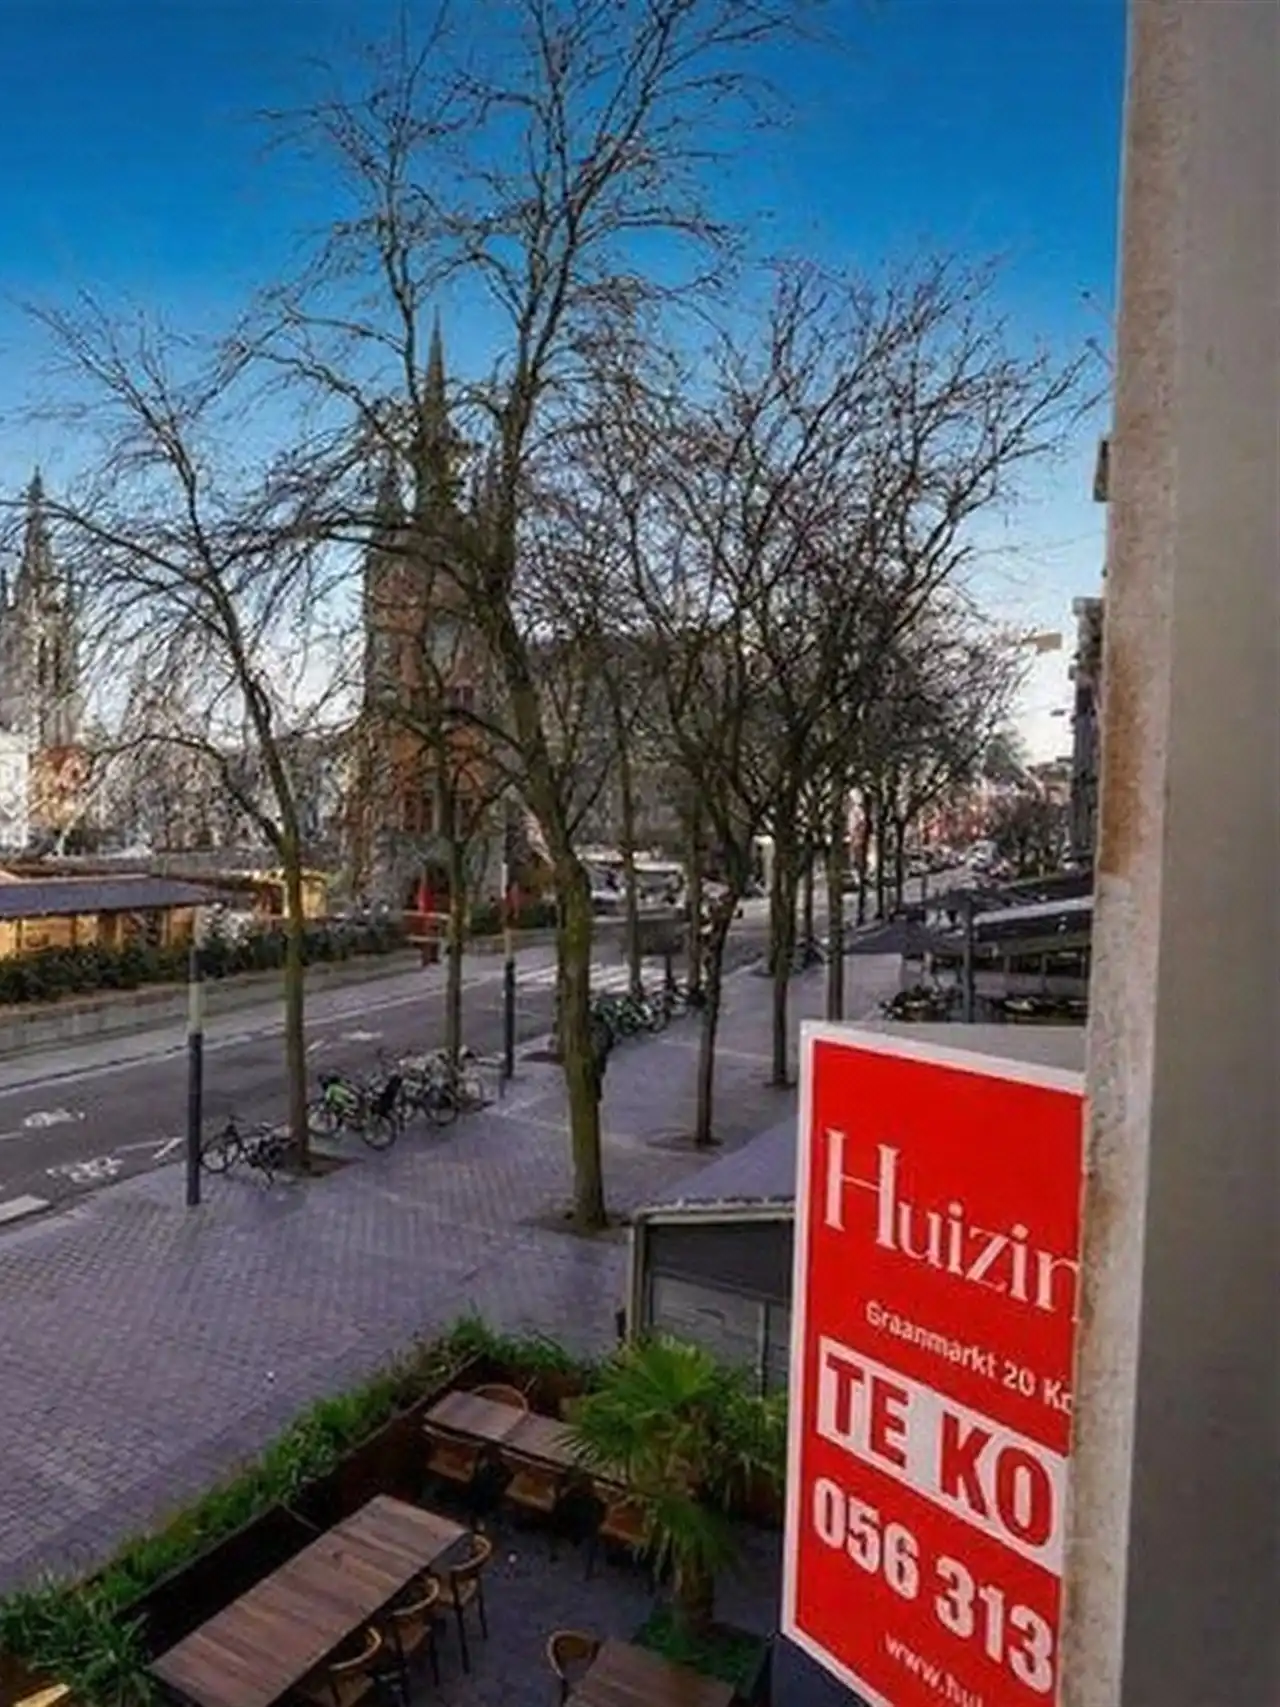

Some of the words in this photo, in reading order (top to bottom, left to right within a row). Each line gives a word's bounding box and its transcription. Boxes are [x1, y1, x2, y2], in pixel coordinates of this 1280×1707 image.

[866, 1301, 995, 1379] Graanmarkt
[1003, 1360, 1036, 1397] 20
[826, 1352, 909, 1469] TE
[940, 1409, 1052, 1547] KO
[813, 1477, 919, 1600] 056
[935, 1555, 1053, 1693] 313
